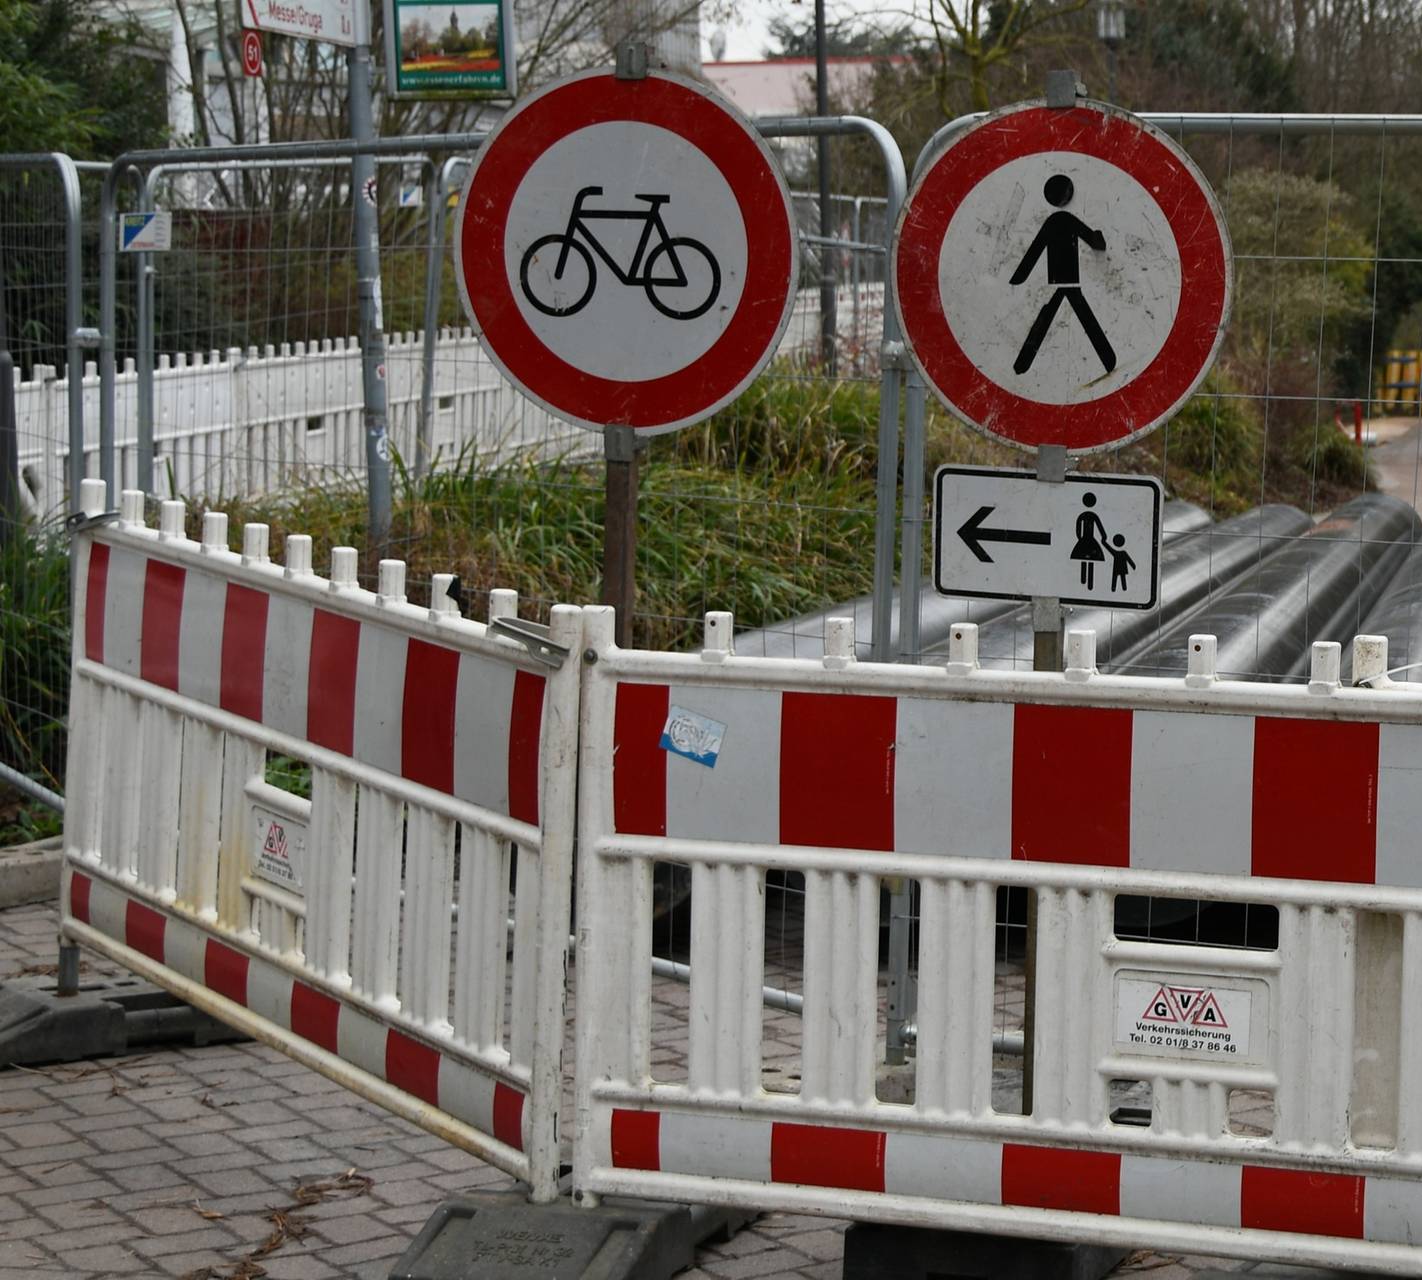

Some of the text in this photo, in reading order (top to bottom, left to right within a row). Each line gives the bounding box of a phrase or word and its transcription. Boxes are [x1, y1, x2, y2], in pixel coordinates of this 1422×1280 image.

[248, 45, 257, 61] 51
[1136, 1022, 1231, 1041] Verkehrssicherung
[1129, 1033, 1236, 1053] Tel. 02 01/8 37 86 46
